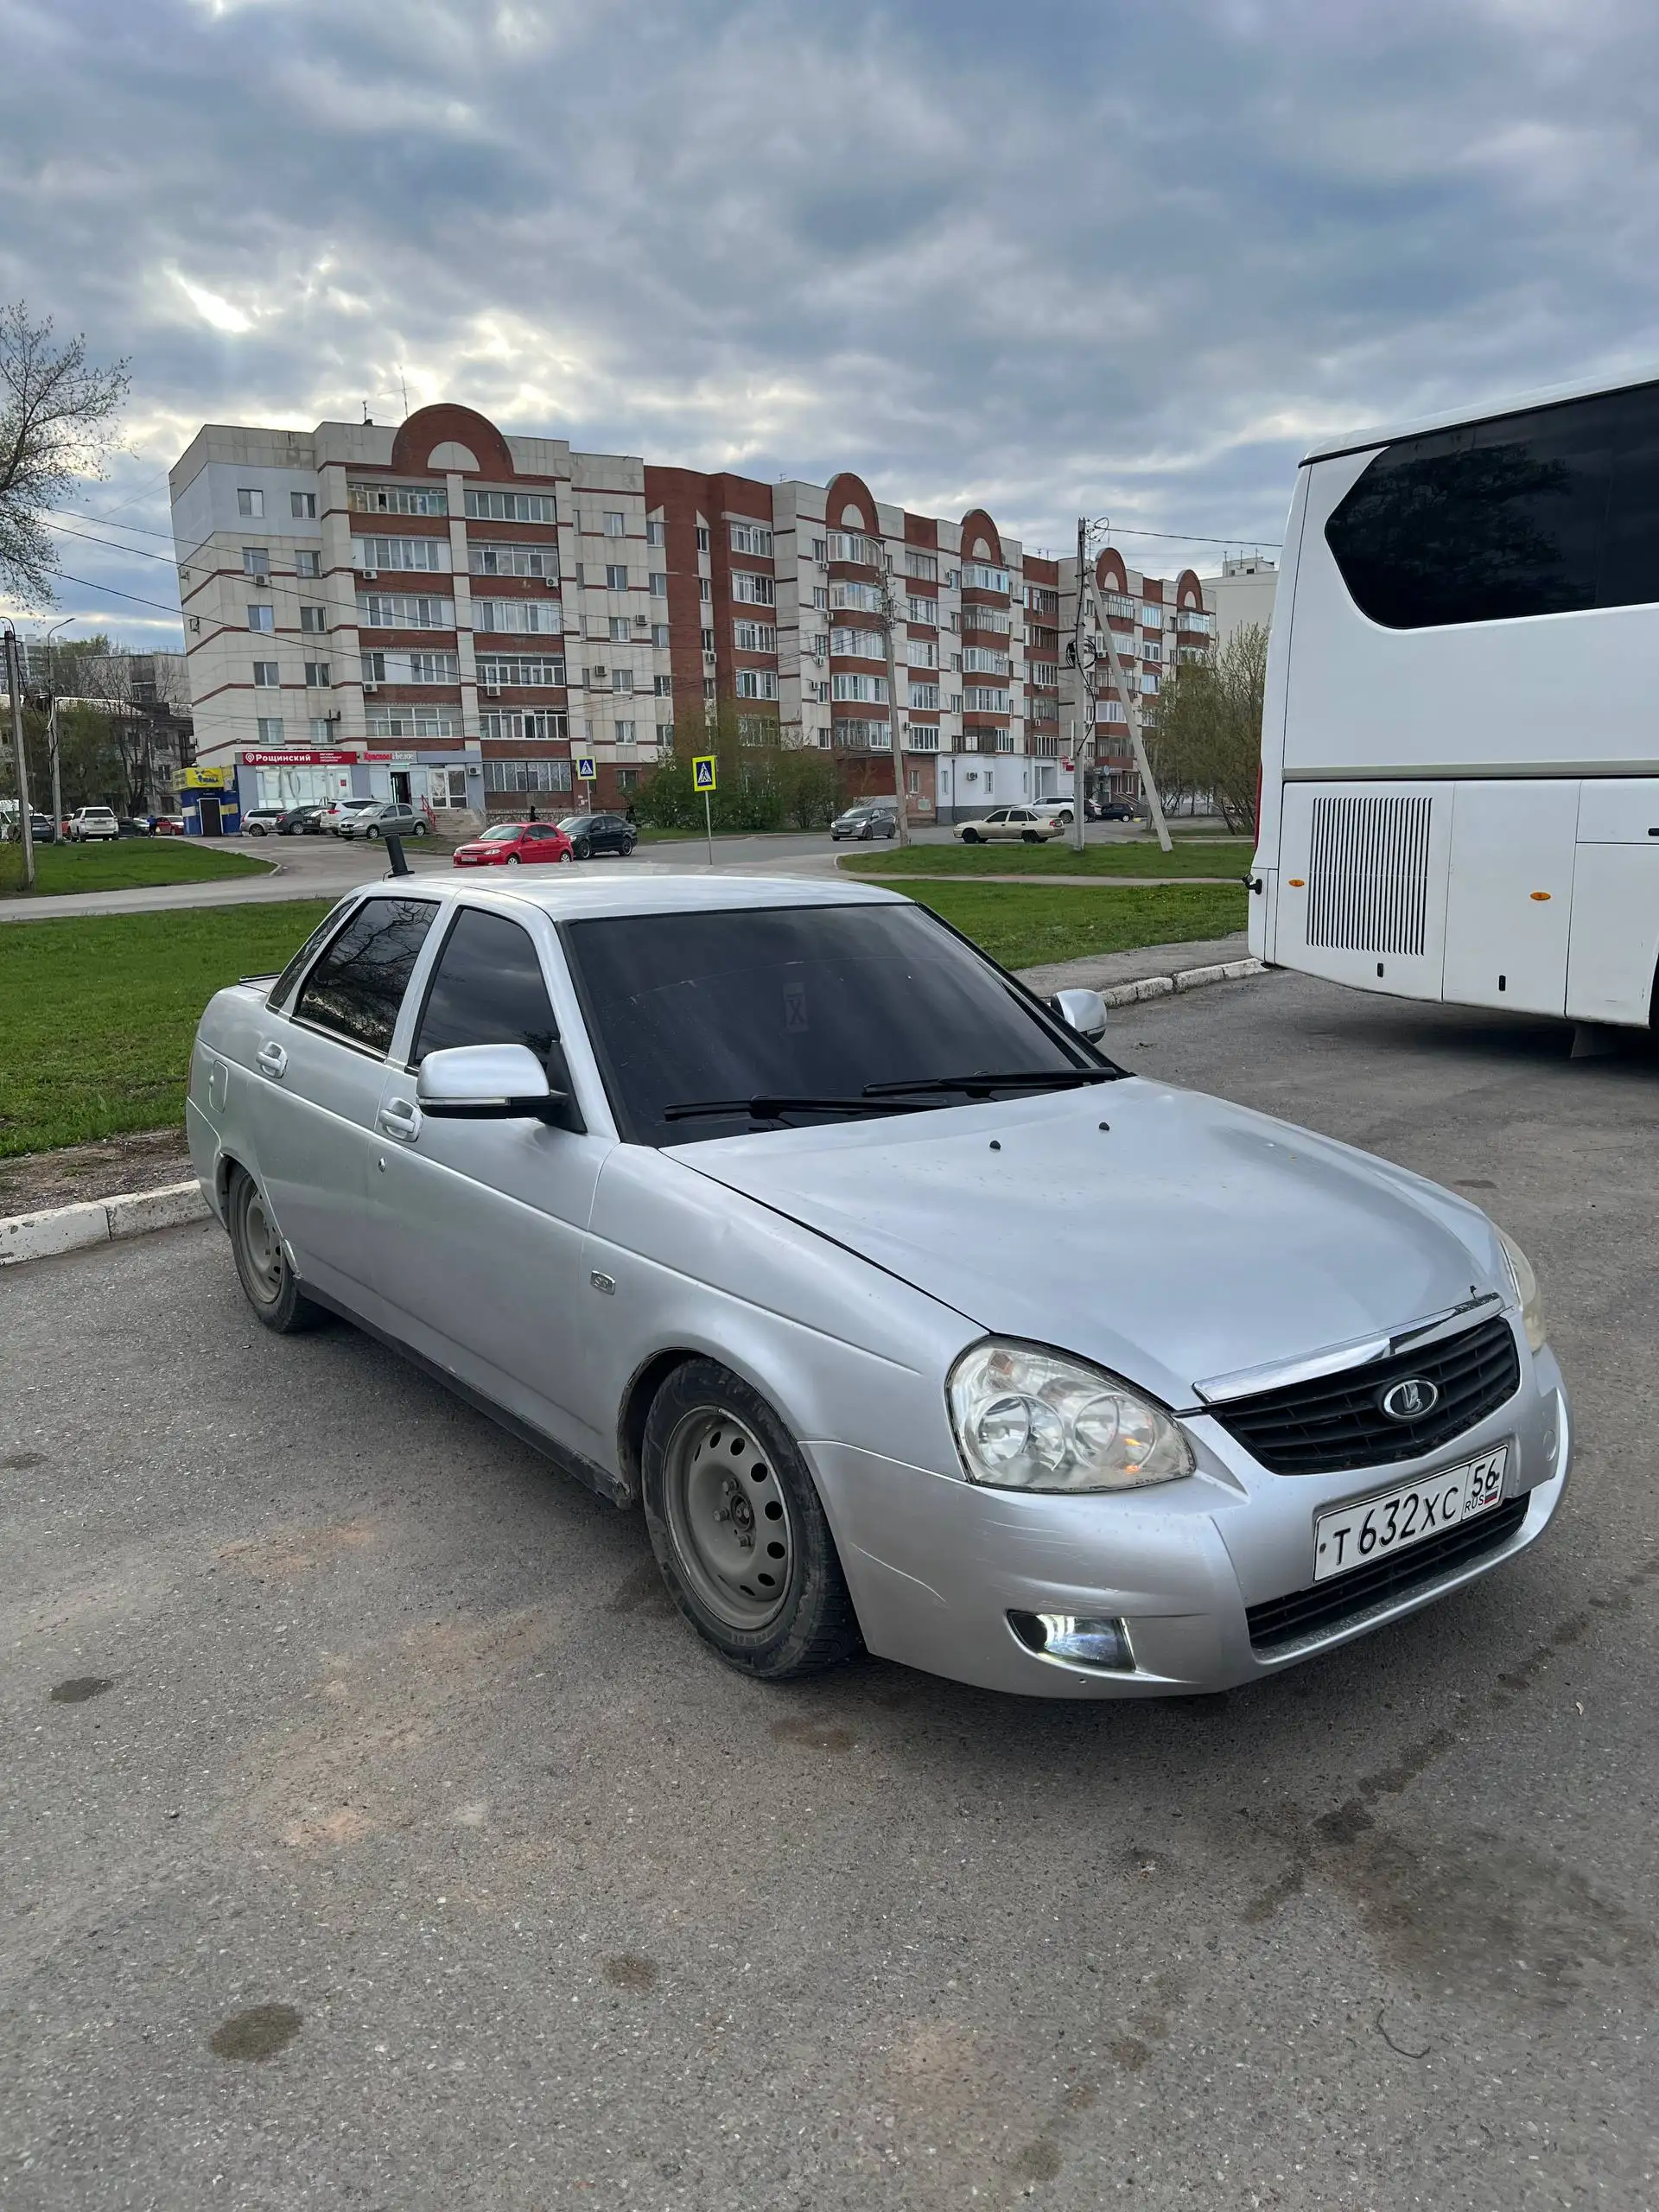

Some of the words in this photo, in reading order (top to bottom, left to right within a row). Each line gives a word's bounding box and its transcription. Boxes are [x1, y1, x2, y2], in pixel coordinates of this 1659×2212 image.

[256, 753, 312, 762] Рощинский
[1471, 1458, 1497, 1497] 56
[1464, 1493, 1485, 1514] RUS
